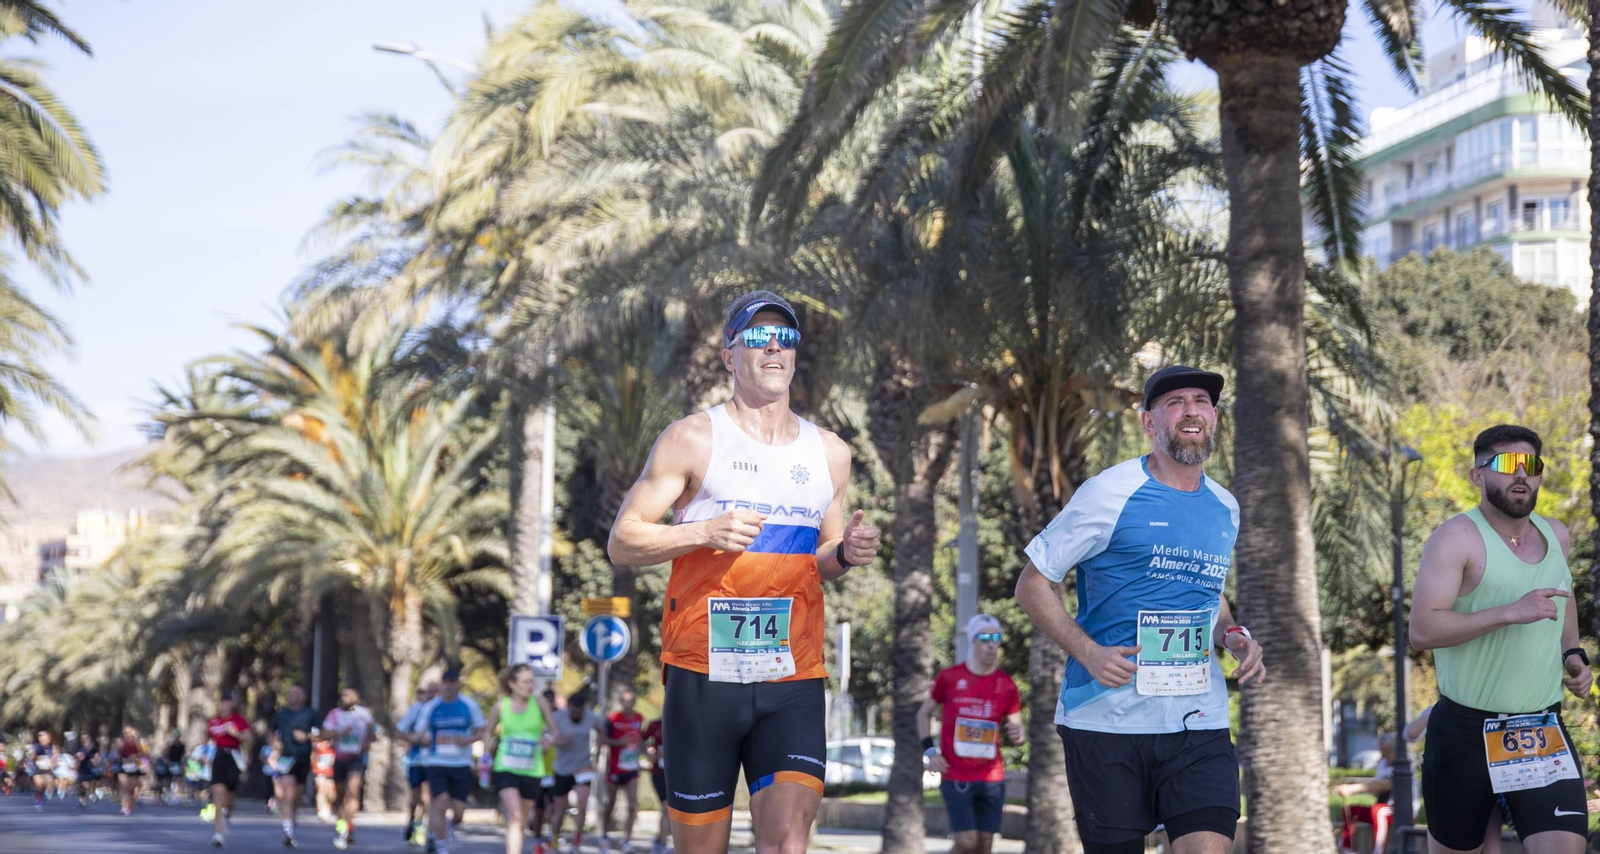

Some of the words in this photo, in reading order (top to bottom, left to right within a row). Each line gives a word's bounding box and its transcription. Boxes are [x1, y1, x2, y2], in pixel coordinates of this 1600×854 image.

[733, 461, 758, 473] GOBIK
[1152, 544, 1189, 558] Medio
[1146, 571, 1175, 581] RAMÓN
[1176, 574, 1193, 584] RUIZ
[1149, 556, 1200, 573] Almería
[1200, 562, 1229, 579] 2025
[730, 615, 778, 639] 714
[514, 618, 557, 668] P
[1158, 627, 1203, 652] 715
[1502, 728, 1547, 752] 659
[673, 790, 725, 800] TRIBARIA
